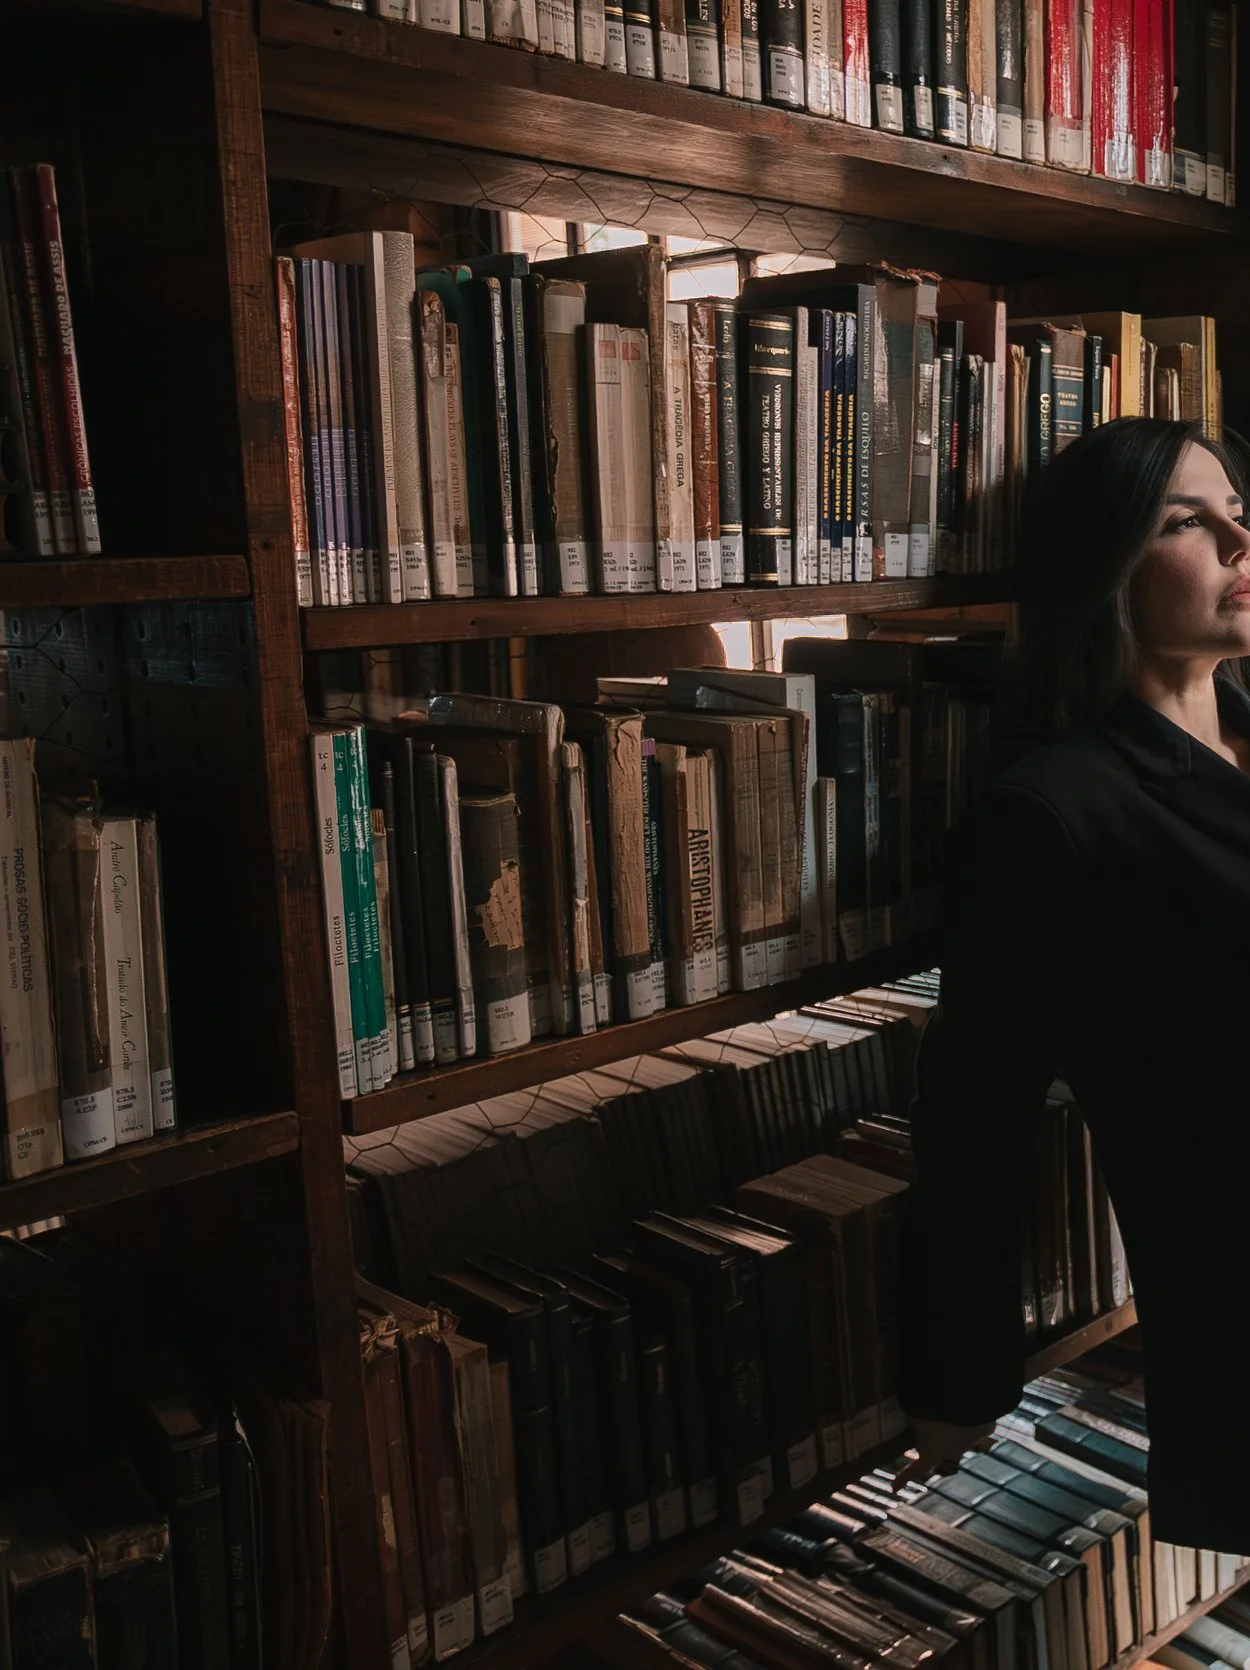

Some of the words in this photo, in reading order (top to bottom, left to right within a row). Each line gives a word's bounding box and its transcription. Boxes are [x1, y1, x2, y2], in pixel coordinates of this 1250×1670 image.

[49, 240, 64, 273] ASSIS
[53, 273, 66, 292] DE
[57, 295, 74, 355] MACHADO
[862, 300, 872, 343] NOGUEIRA
[861, 344, 871, 380] RICARDO
[674, 386, 682, 394] A
[773, 383, 783, 430] VERSIONES
[673, 398, 684, 448] TRAGÉDIA
[761, 394, 772, 429] TEATRO
[1040, 393, 1052, 440] GREGO
[761, 432, 771, 464] GRIEGO
[822, 442, 831, 455] DA
[833, 442, 843, 455] DA
[858, 411, 871, 459] ESQUILO
[450, 449, 461, 460] OF
[675, 452, 685, 488] GREGA
[762, 467, 771, 475] Y
[773, 431, 783, 507] REPRESENTABLES
[858, 461, 870, 478] DE
[762, 477, 772, 510] LATINO
[822, 459, 831, 510] NASCIMENTO
[833, 459, 843, 513] NASCIMENTO
[320, 763, 326, 771] 4
[14, 847, 27, 894] PROSAS
[110, 840, 125, 873] André
[324, 816, 335, 855] Sófocles
[332, 914, 344, 967] Filoctetes
[340, 814, 351, 853] Sófocles
[347, 911, 360, 964] Filoctetes
[688, 828, 714, 954] ARISTOPHANES
[20, 935, 34, 993] POLÍTICAS
[119, 1008, 135, 1038] Amor
